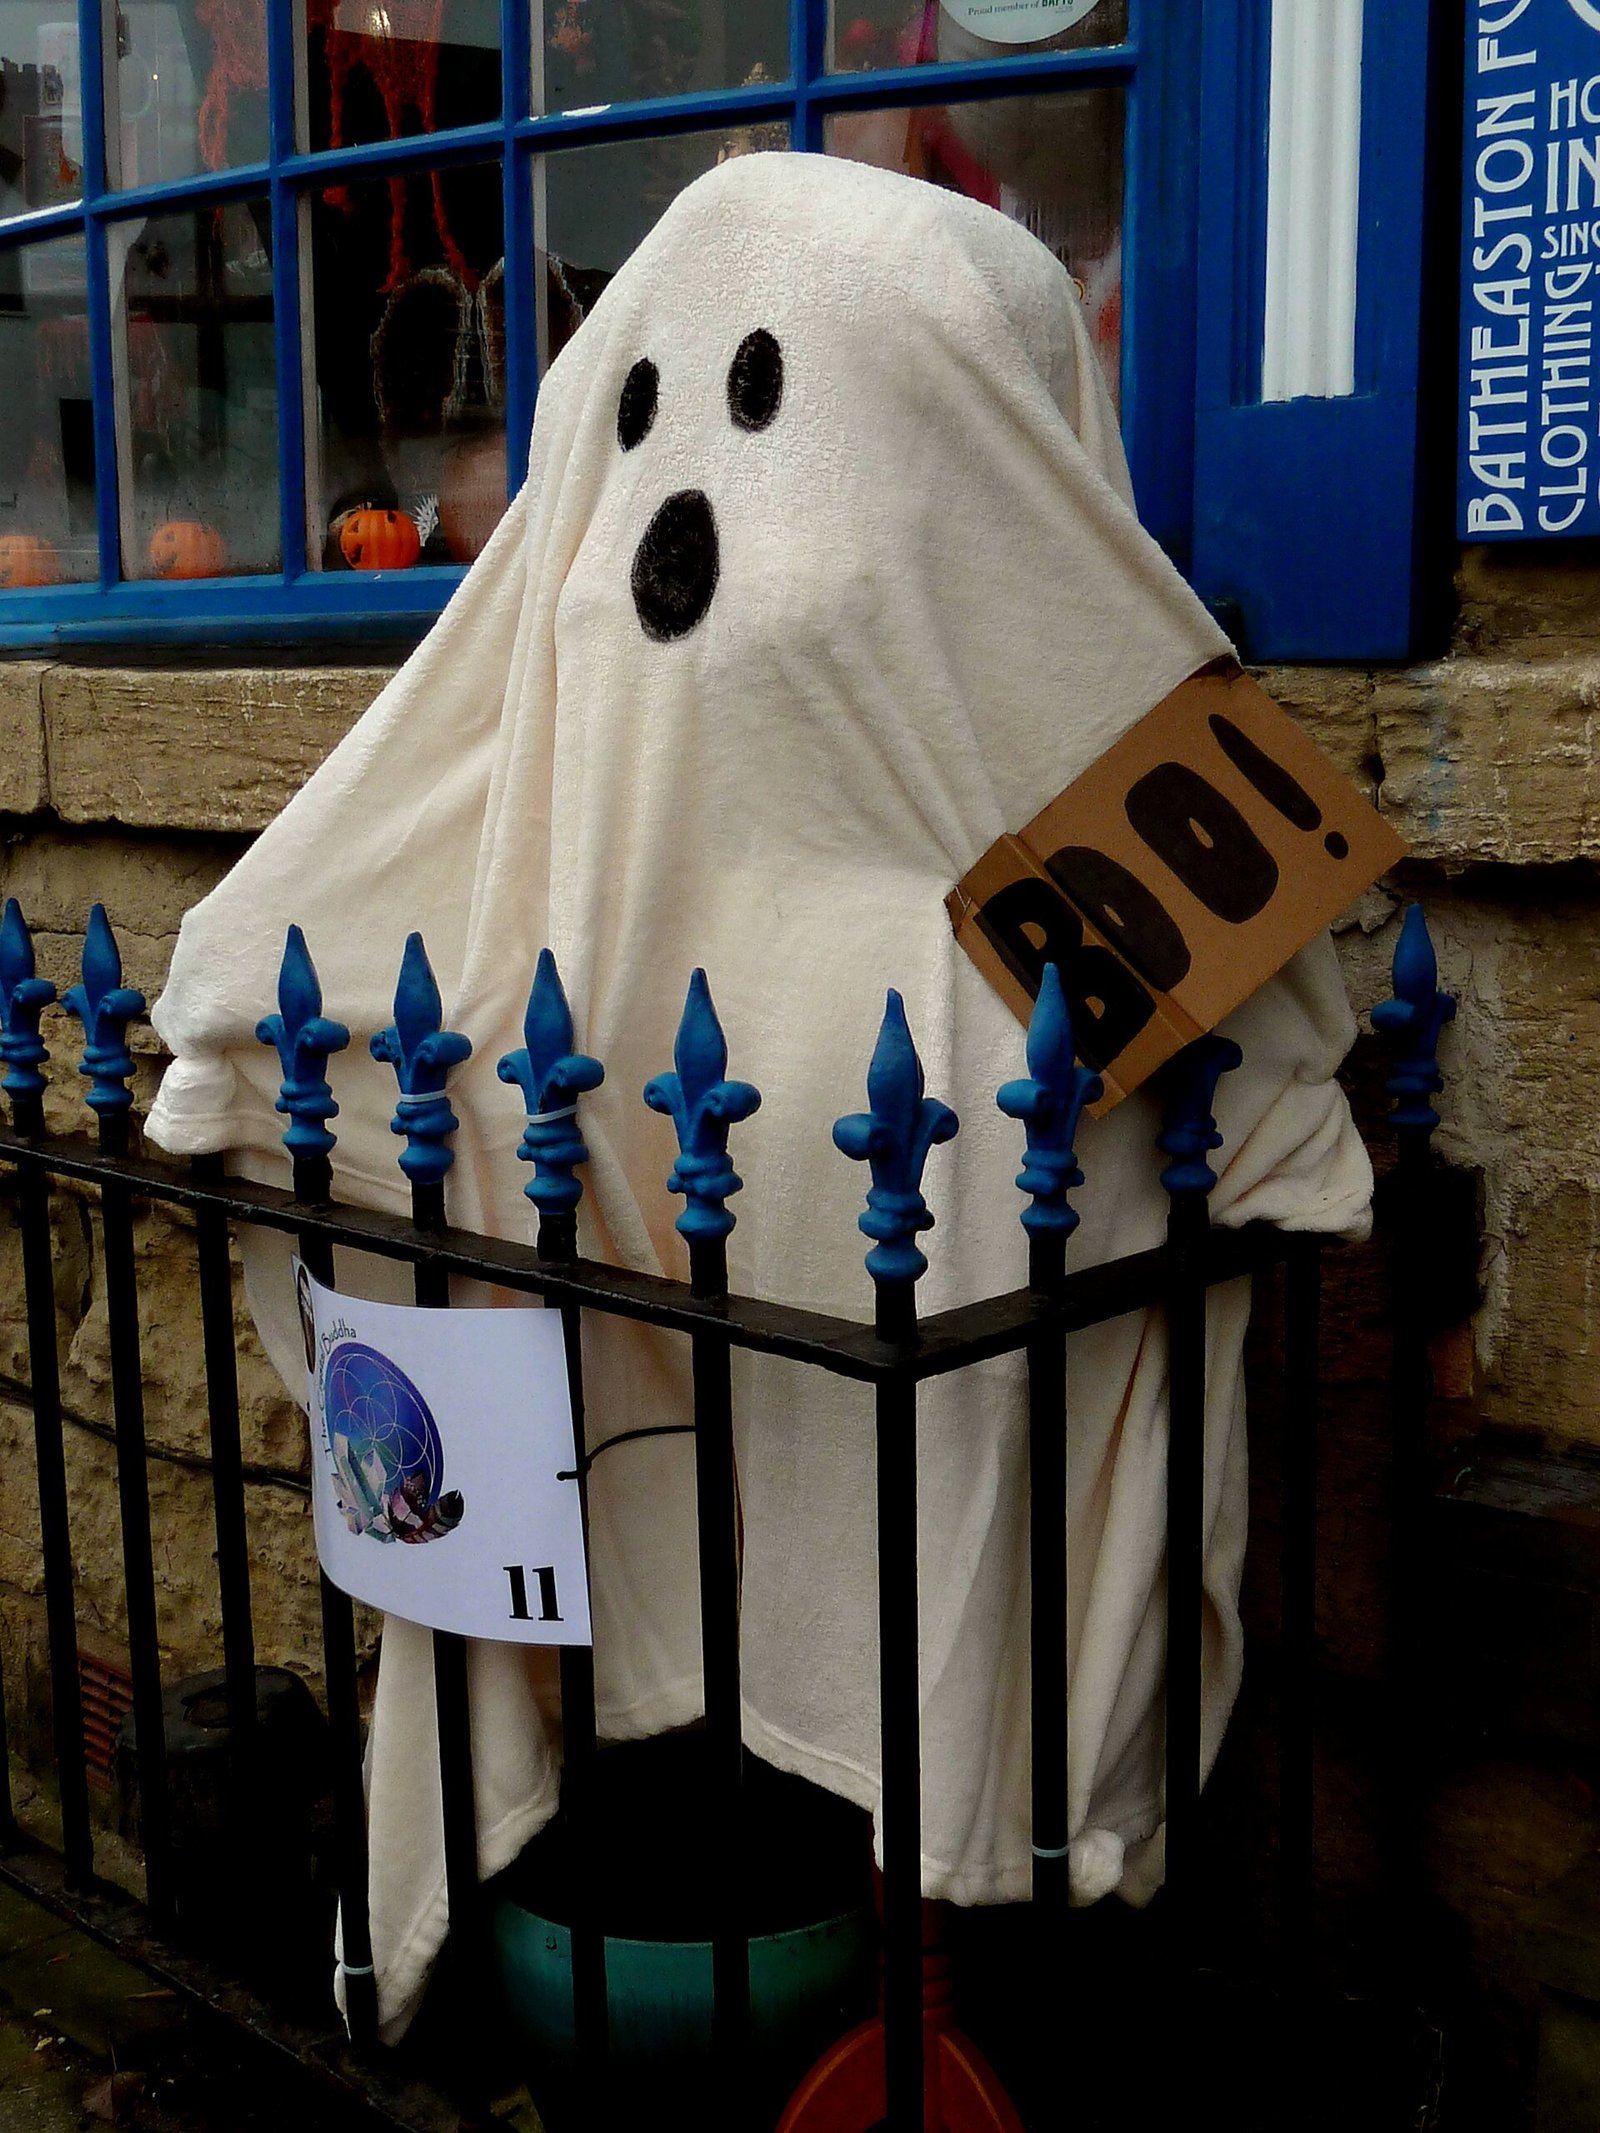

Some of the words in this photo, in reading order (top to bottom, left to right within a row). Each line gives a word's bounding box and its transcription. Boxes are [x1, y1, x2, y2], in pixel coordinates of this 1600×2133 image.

[968, 6, 993, 15] Proud
[994, 2, 1028, 13] member
[1030, 1, 1039, 9] of
[1467, 89, 1536, 533] BATHEASTON
[1538, 261, 1593, 532] CLOTHING
[973, 714, 1350, 1072] BOO!
[321, 1318, 356, 1354] Buddha
[502, 1565, 565, 1622] 11
